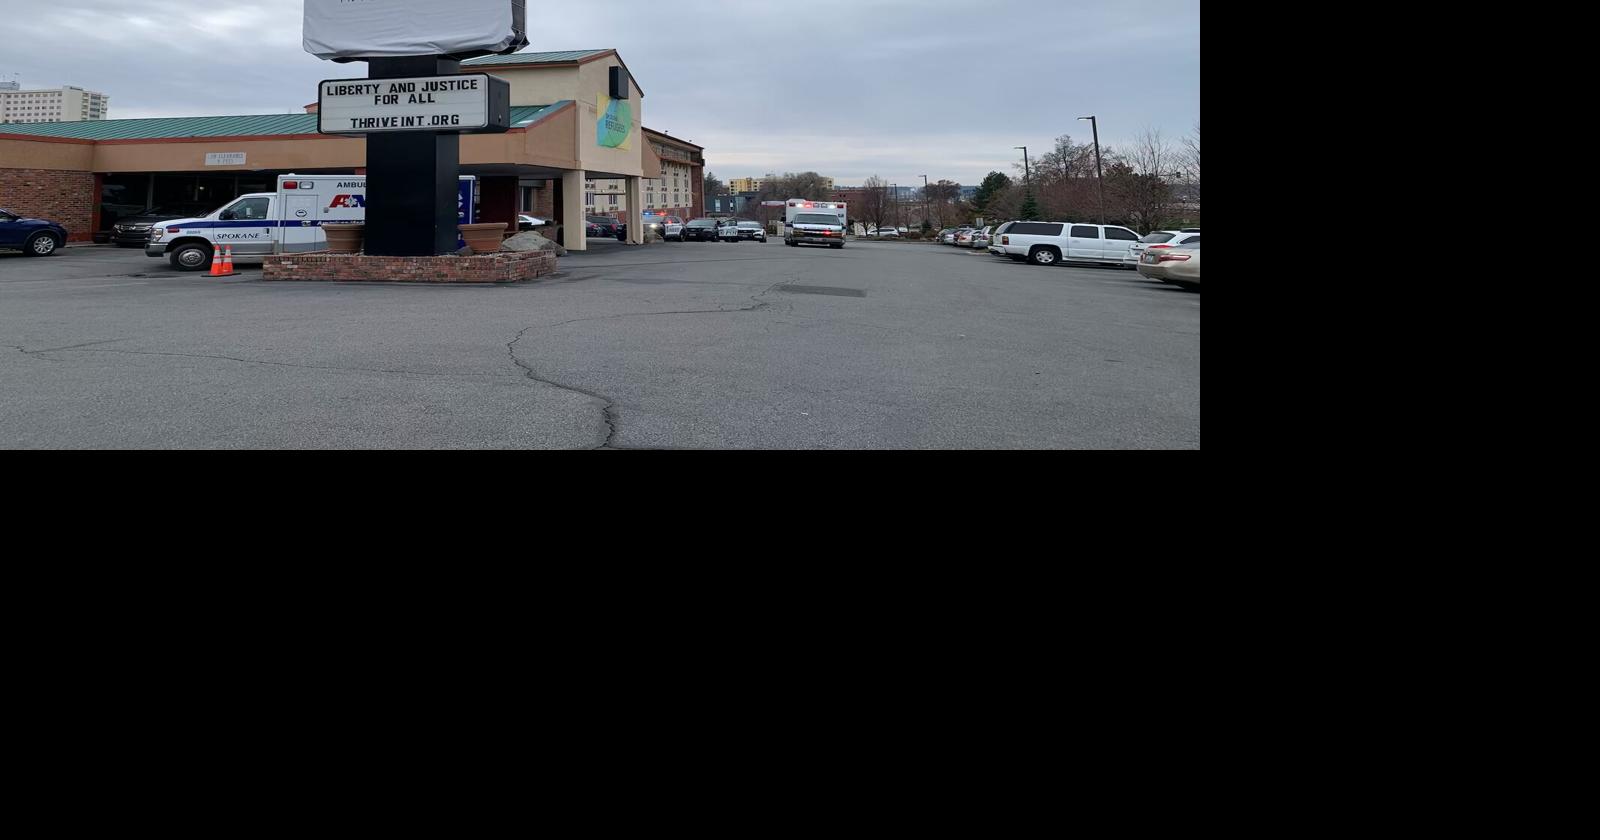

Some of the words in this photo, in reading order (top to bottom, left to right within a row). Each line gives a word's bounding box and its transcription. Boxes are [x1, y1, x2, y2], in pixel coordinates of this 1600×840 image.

[327, 84, 380, 96] LIBERTY
[389, 82, 415, 93] AND
[421, 79, 478, 92] JUSTICE
[374, 95, 398, 105] FOR
[408, 93, 435, 104] ALL
[216, 232, 260, 240] SPOKANE
